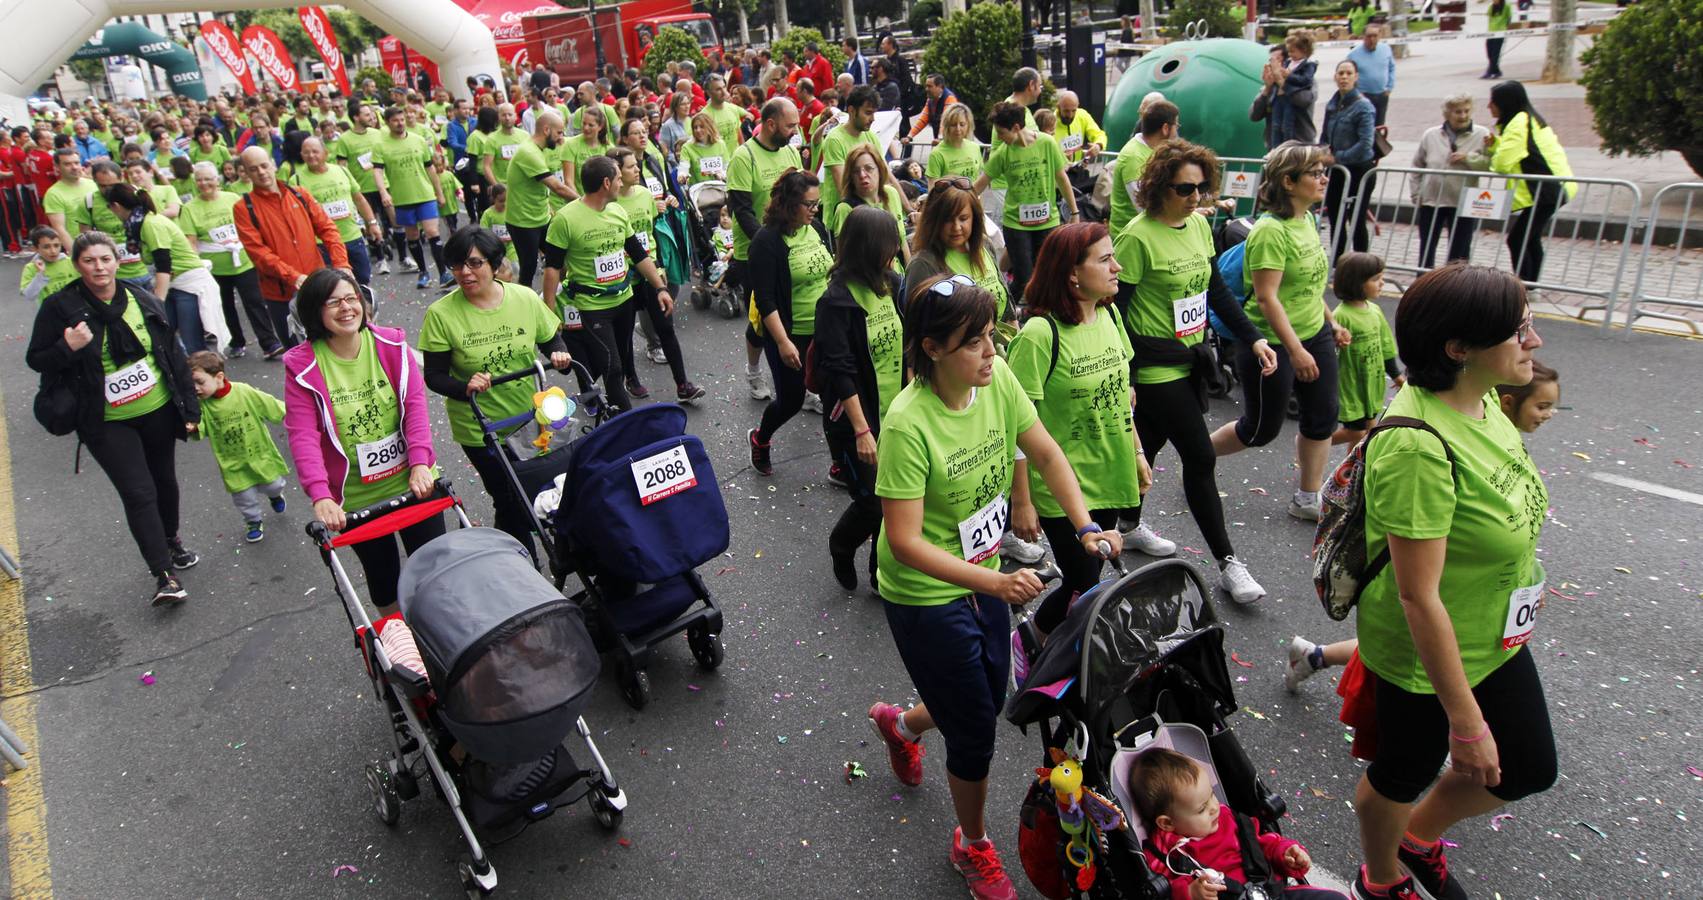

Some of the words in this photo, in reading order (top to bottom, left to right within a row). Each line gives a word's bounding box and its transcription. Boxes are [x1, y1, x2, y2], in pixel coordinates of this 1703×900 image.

[139, 41, 172, 54] DKV
[1094, 47, 1103, 63] P
[172, 71, 200, 82] DKV
[703, 160, 721, 169] 1435
[1023, 209, 1048, 218] 1105
[599, 257, 624, 273] 0813
[568, 311, 580, 321] 07
[1076, 361, 1099, 374] Carrera
[1102, 355, 1120, 367] Familia
[108, 370, 149, 394] 0396
[366, 439, 406, 468] 2890
[945, 447, 967, 464] Logroño
[952, 457, 979, 476] Carrera
[983, 437, 1005, 458] Familia
[373, 470, 393, 480] Carrera
[643, 459, 687, 489] 2088
[652, 490, 671, 500] Carrera
[674, 481, 692, 492] Familia
[1515, 600, 1539, 628] 06
